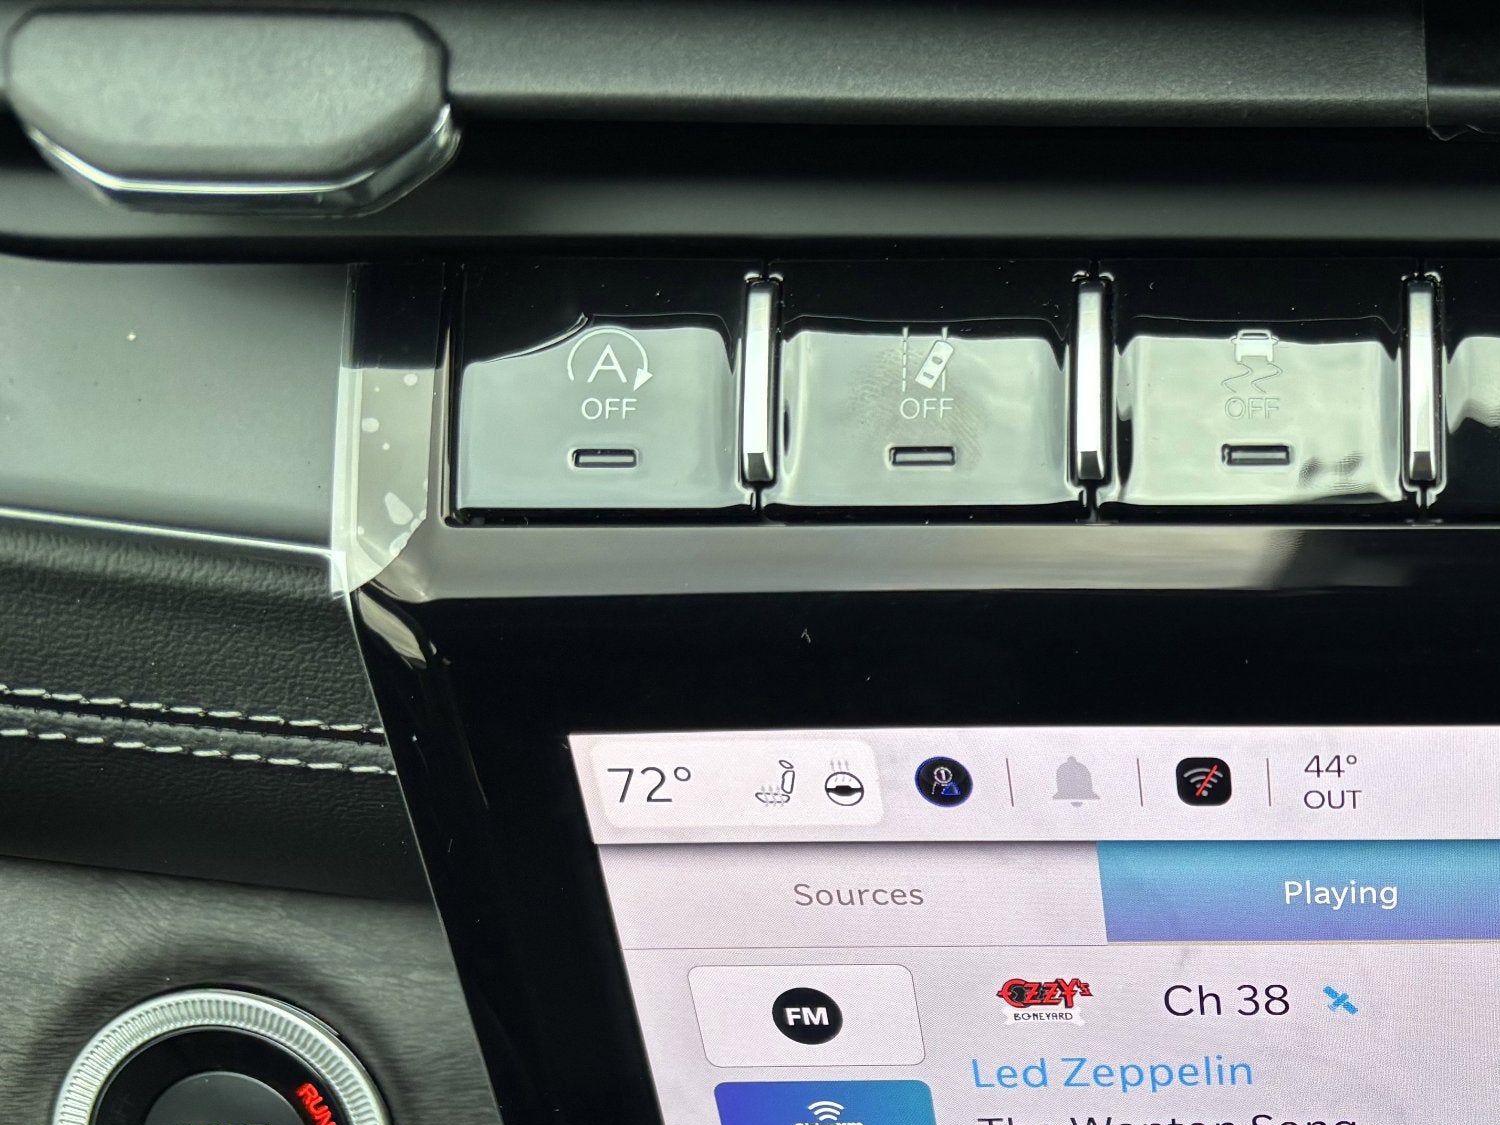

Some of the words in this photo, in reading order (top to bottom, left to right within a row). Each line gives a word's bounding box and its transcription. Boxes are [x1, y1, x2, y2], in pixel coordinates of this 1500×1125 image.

[580, 397, 637, 421] OFF
[900, 397, 955, 420] OFF
[1224, 396, 1280, 420] OFF
[1303, 753, 1359, 779] 44°
[606, 766, 692, 804] 72°
[1303, 790, 1362, 811] OUT
[792, 881, 925, 907] Sources
[1283, 879, 1400, 911] Playing
[1163, 983, 1223, 1017] Ch
[1236, 983, 1291, 1017] 38
[784, 1006, 830, 1027] FM
[1012, 1011, 1074, 1022] BONEYARD
[971, 1057, 1048, 1089] Led
[1060, 1053, 1254, 1094] Zeppelin
